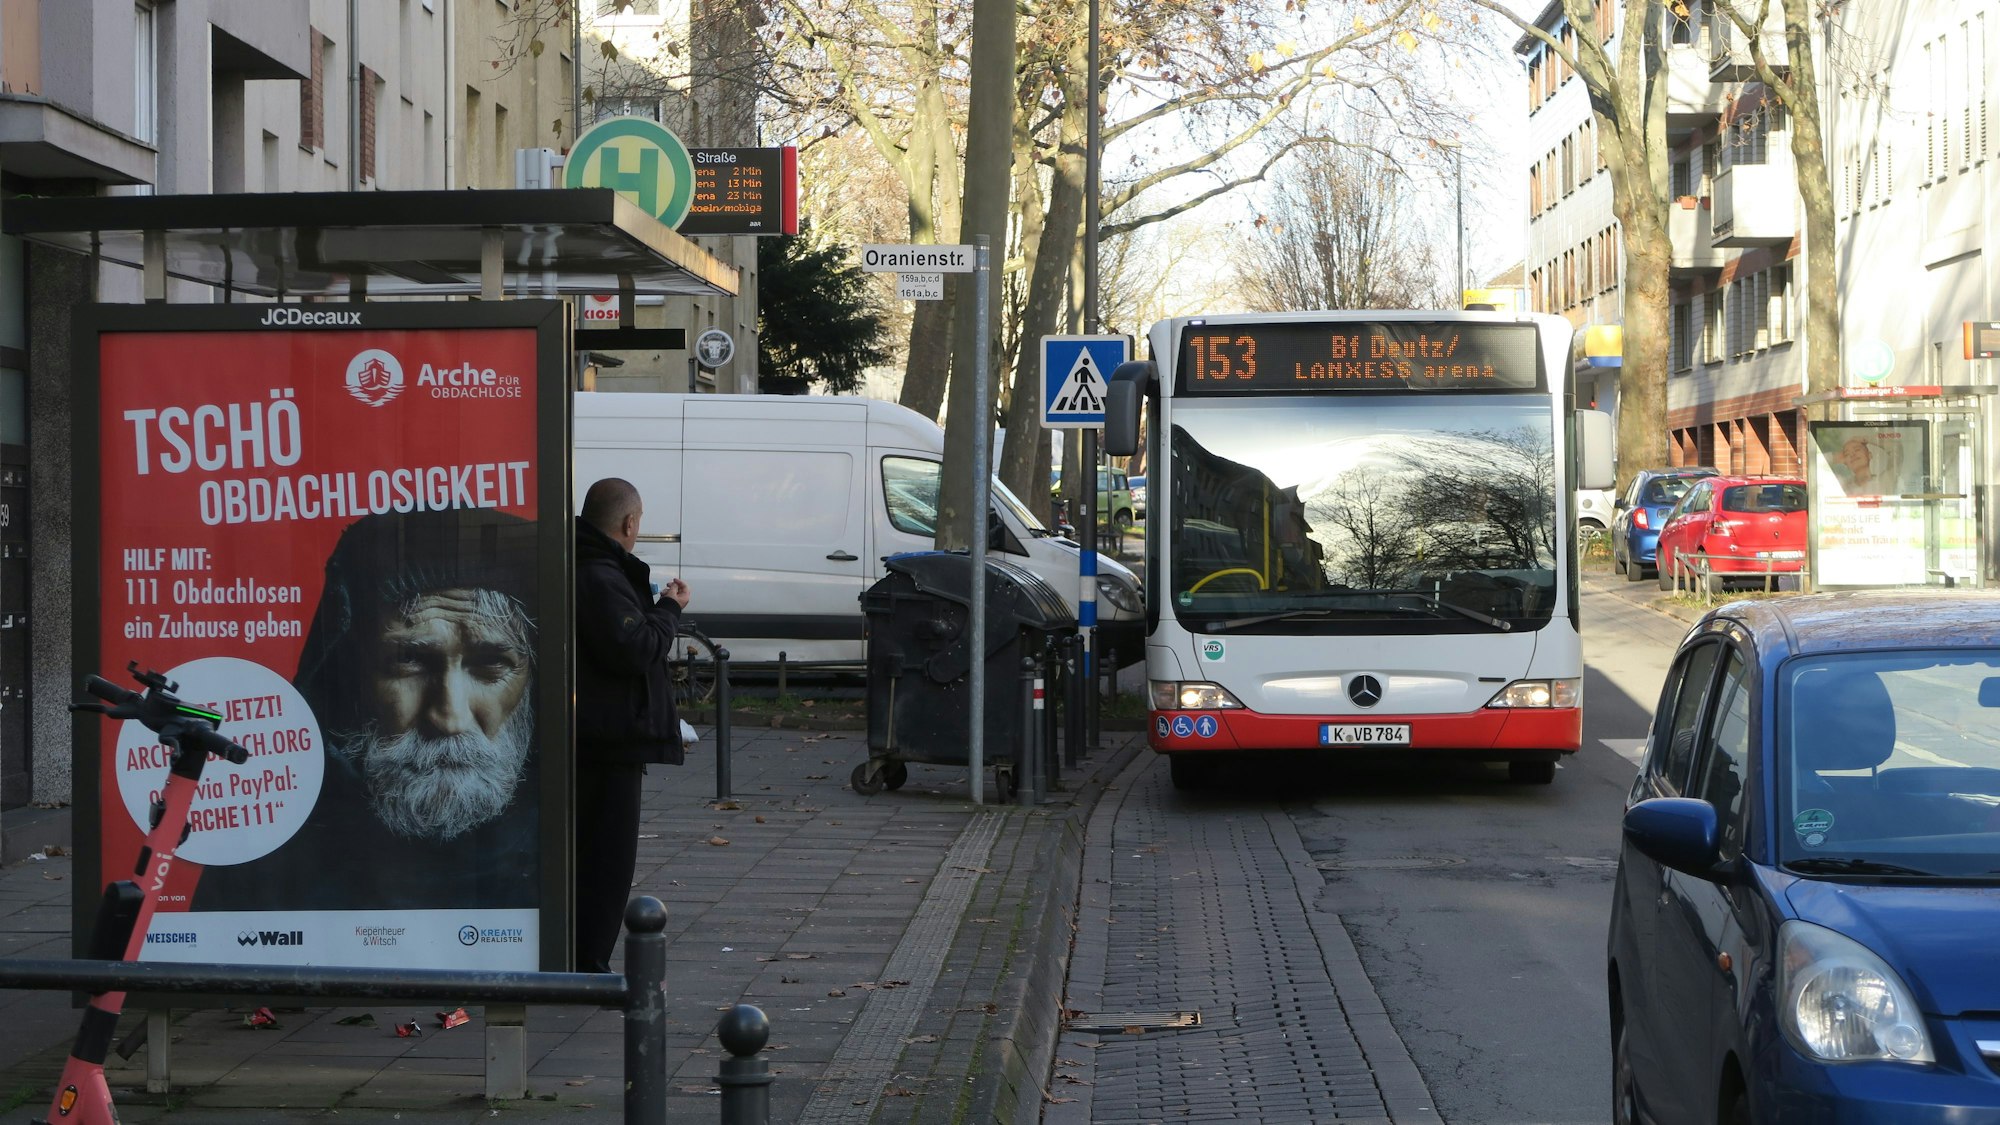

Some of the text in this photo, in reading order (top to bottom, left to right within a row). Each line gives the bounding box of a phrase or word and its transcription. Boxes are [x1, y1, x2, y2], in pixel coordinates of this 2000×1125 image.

[696, 152, 737, 163] Straße
[732, 167, 740, 176] 2
[743, 167, 762, 176] Min
[728, 179, 740, 188] 13
[743, 179, 762, 188] Min
[727, 191, 740, 200] 23
[743, 191, 762, 200] Min
[865, 250, 965, 266] Oranienstr.
[901, 275, 940, 284] 159a,b,c,d
[901, 289, 939, 298] 161a,b,c
[260, 309, 362, 326] JCDecaux
[1331, 334, 1460, 359] Bf Deutz/
[1190, 335, 1257, 380] 153
[417, 362, 520, 387] Arche FÜR
[1295, 361, 1496, 379] LANXESS arena
[431, 387, 522, 398] OBDACHLOSE
[124, 388, 301, 475] TSCHÖ
[200, 461, 530, 525] OBDACHLOSIGKEIT
[124, 547, 212, 572] HILF MIT:
[125, 578, 301, 605] 111 Obdachlosen
[124, 612, 301, 645] ein Zuhause geben
[1203, 644, 1219, 652] VRS
[224, 695, 283, 722] JETZT!
[1333, 727, 1343, 742] K
[1354, 727, 1373, 742] VB
[1375, 727, 1403, 742] 784
[195, 777, 224, 801] via
[229, 765, 298, 800] PayPal:
[190, 801, 284, 833] RCHE111“
[146, 932, 197, 944] WEISCHER
[259, 931, 304, 946] Wall
[355, 925, 405, 938] Kiepenheuer
[481, 929, 523, 937] KREATIV
[363, 936, 397, 946] & Witsch
